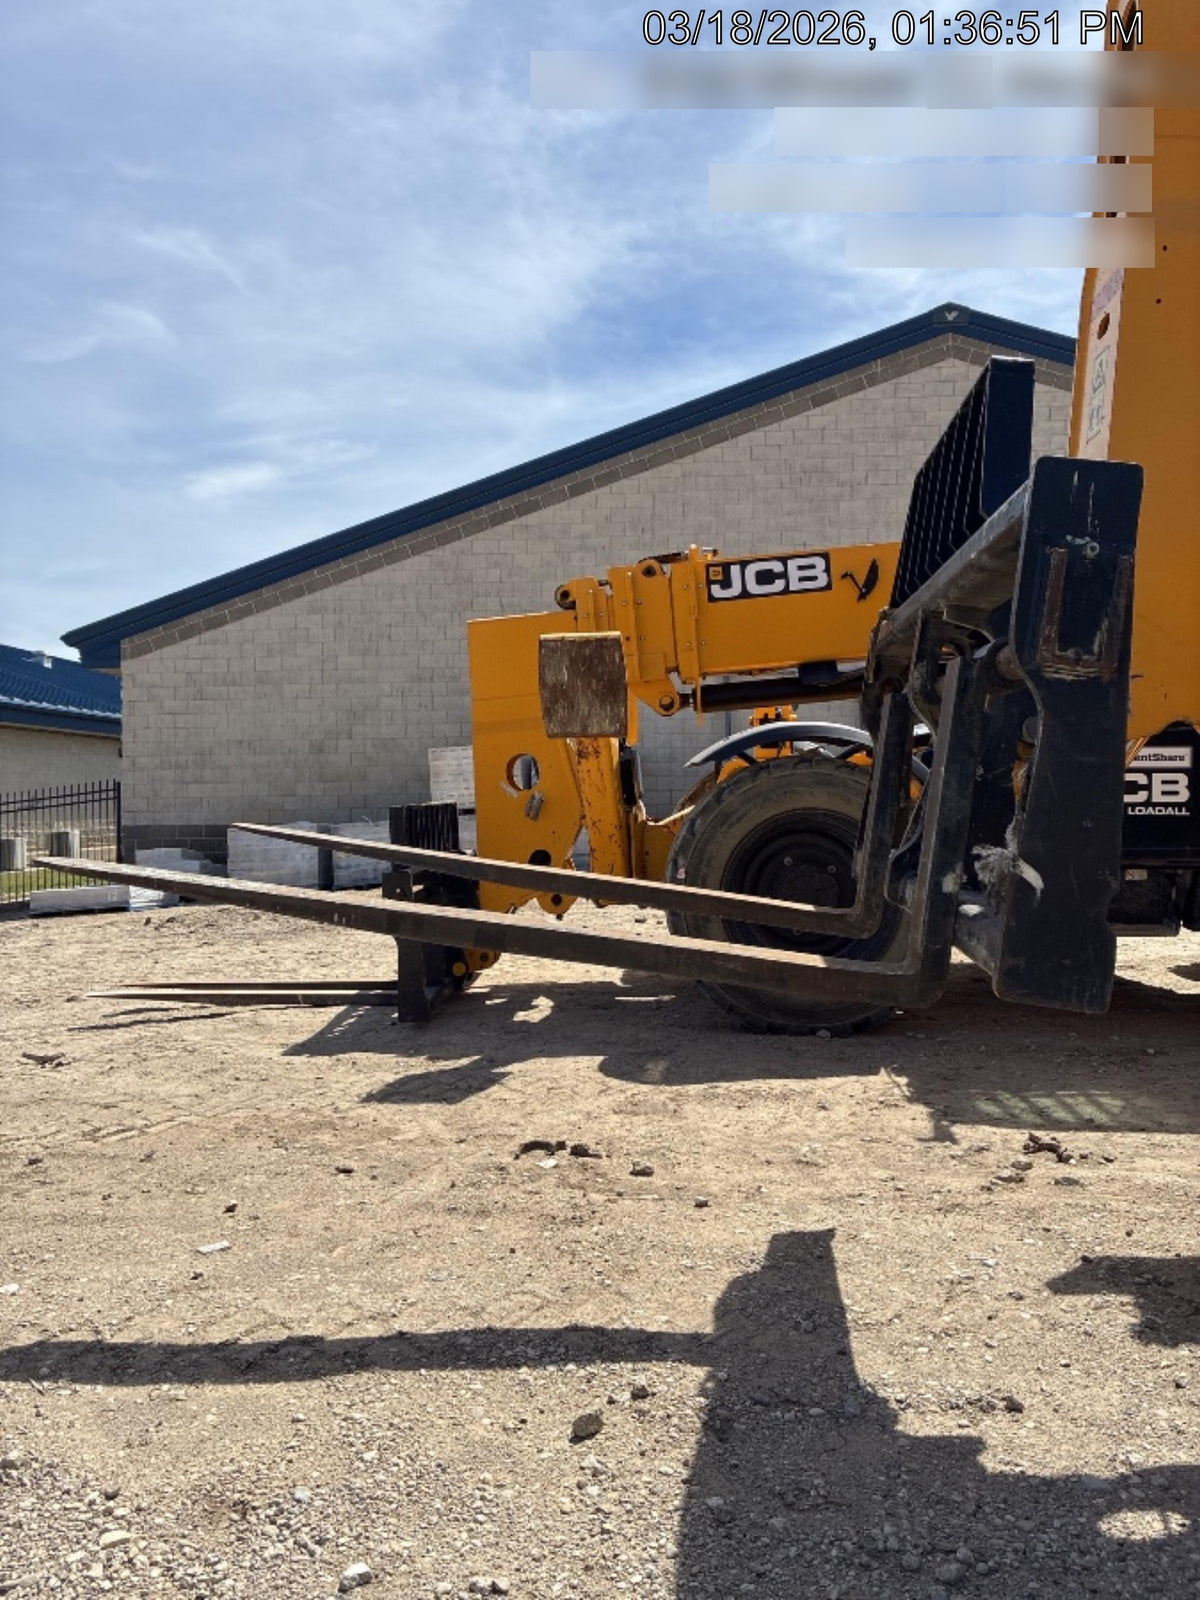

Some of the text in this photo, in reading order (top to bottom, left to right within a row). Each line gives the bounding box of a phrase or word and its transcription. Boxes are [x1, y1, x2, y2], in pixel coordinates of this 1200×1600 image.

[709, 556, 829, 599] JCB
[1133, 752, 1185, 762] entShare
[1123, 772, 1191, 803] CB
[1127, 806, 1191, 816] LOADALL
